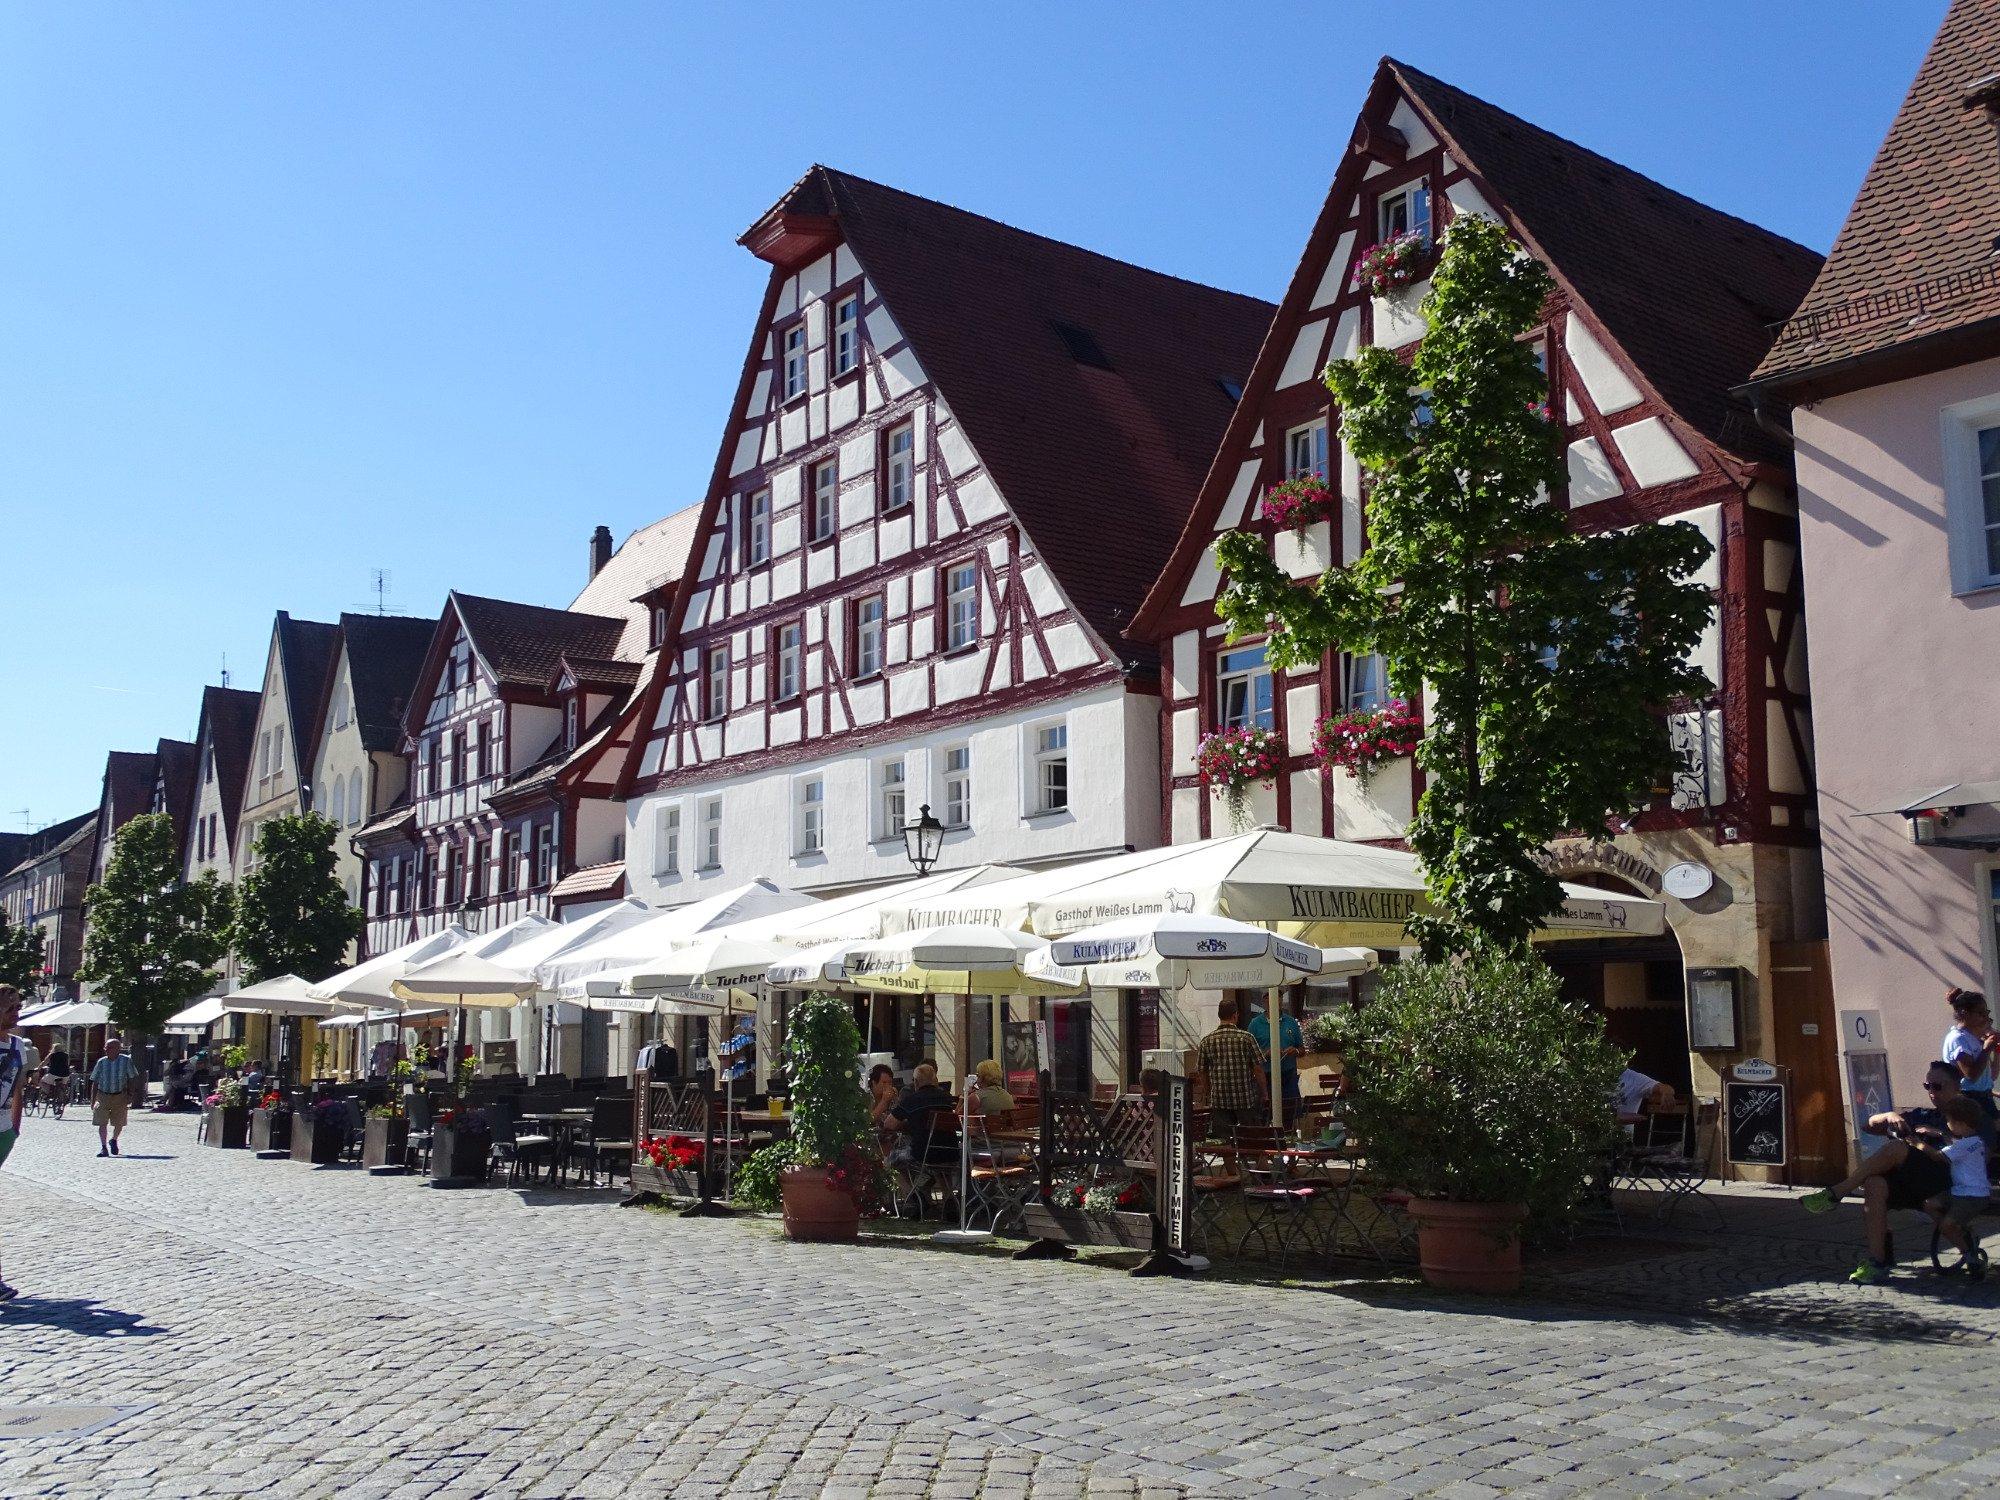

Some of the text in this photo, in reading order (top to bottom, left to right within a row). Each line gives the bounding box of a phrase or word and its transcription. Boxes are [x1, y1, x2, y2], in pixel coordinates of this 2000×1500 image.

[1286, 885, 1416, 919] KULMBACHER
[1055, 902, 1163, 922] Gasthof Weißes Lamm
[1579, 909, 1603, 920] Lamm
[1073, 940, 1136, 959] KULMBACHER
[855, 958, 896, 972] Tucher
[716, 972, 766, 988] Tucher
[1171, 1086, 1183, 1245] FREMDENZIMMER
